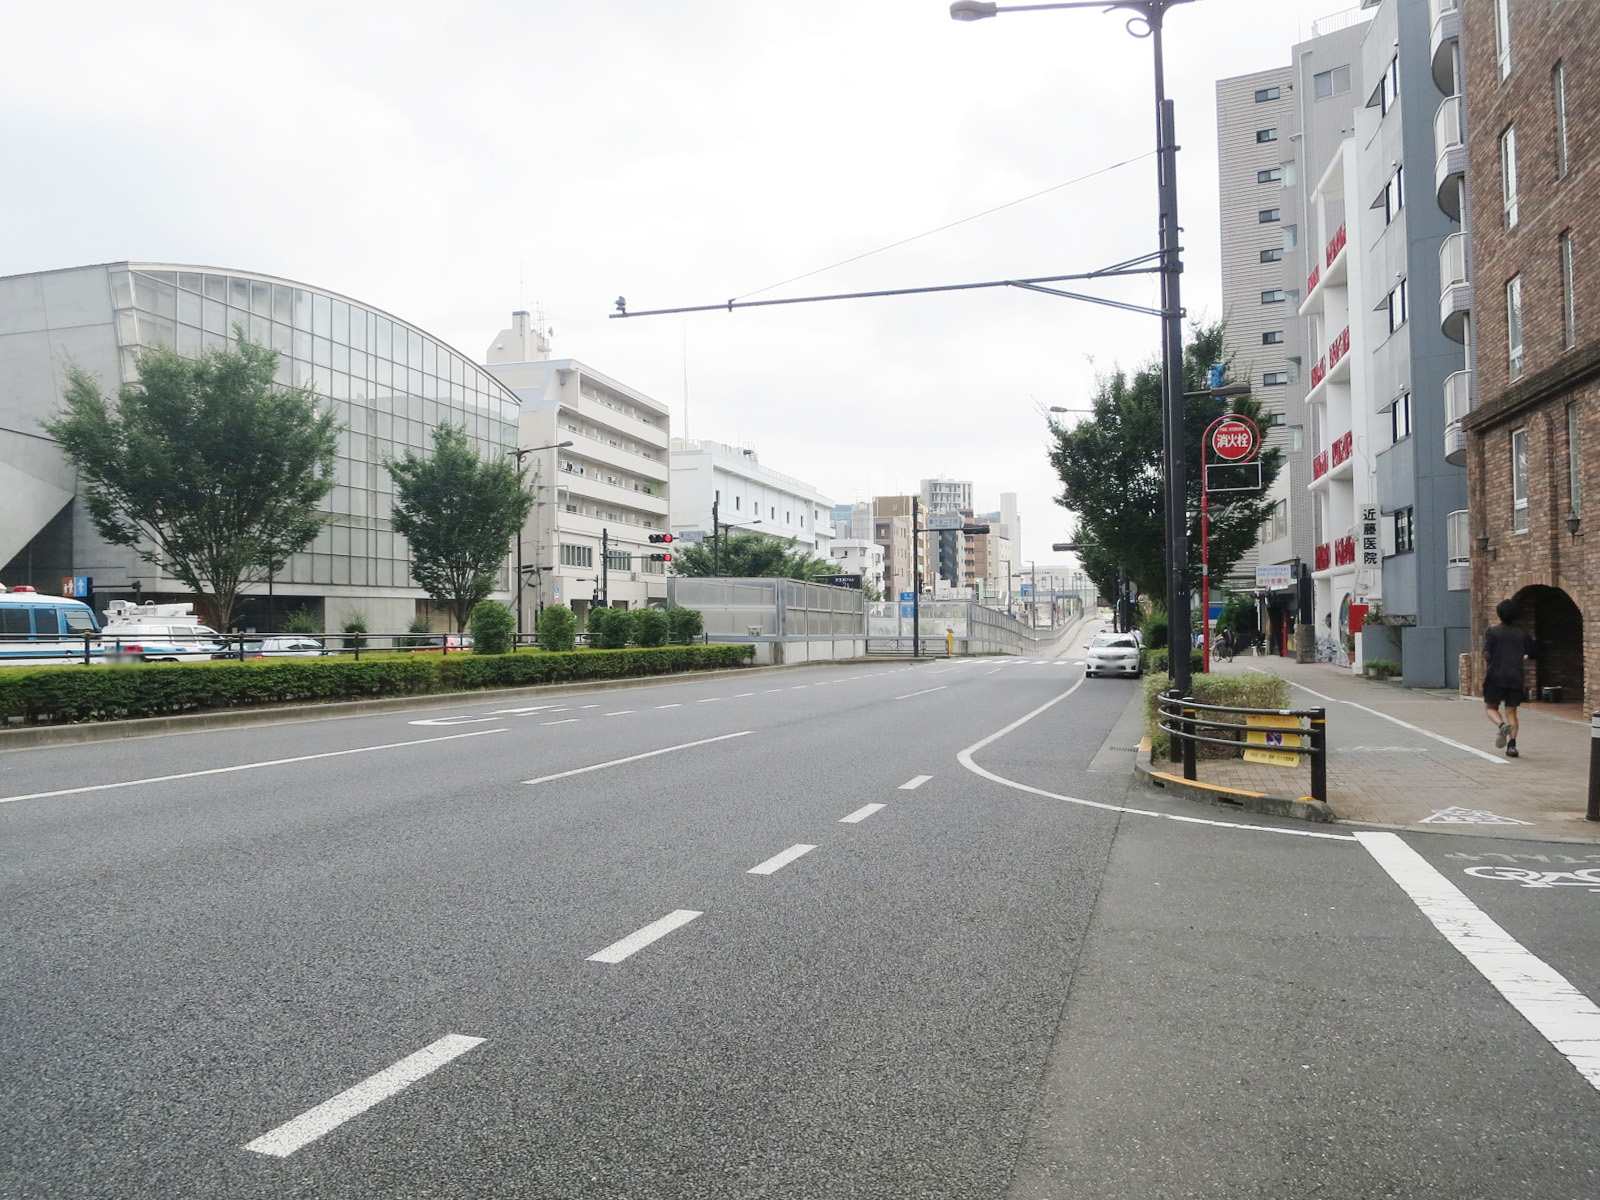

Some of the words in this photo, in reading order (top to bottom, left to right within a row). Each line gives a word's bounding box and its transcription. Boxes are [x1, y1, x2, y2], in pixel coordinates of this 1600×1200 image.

[1216, 433, 1249, 448] 消火栓
[1363, 508, 1377, 565] 近藤医院
